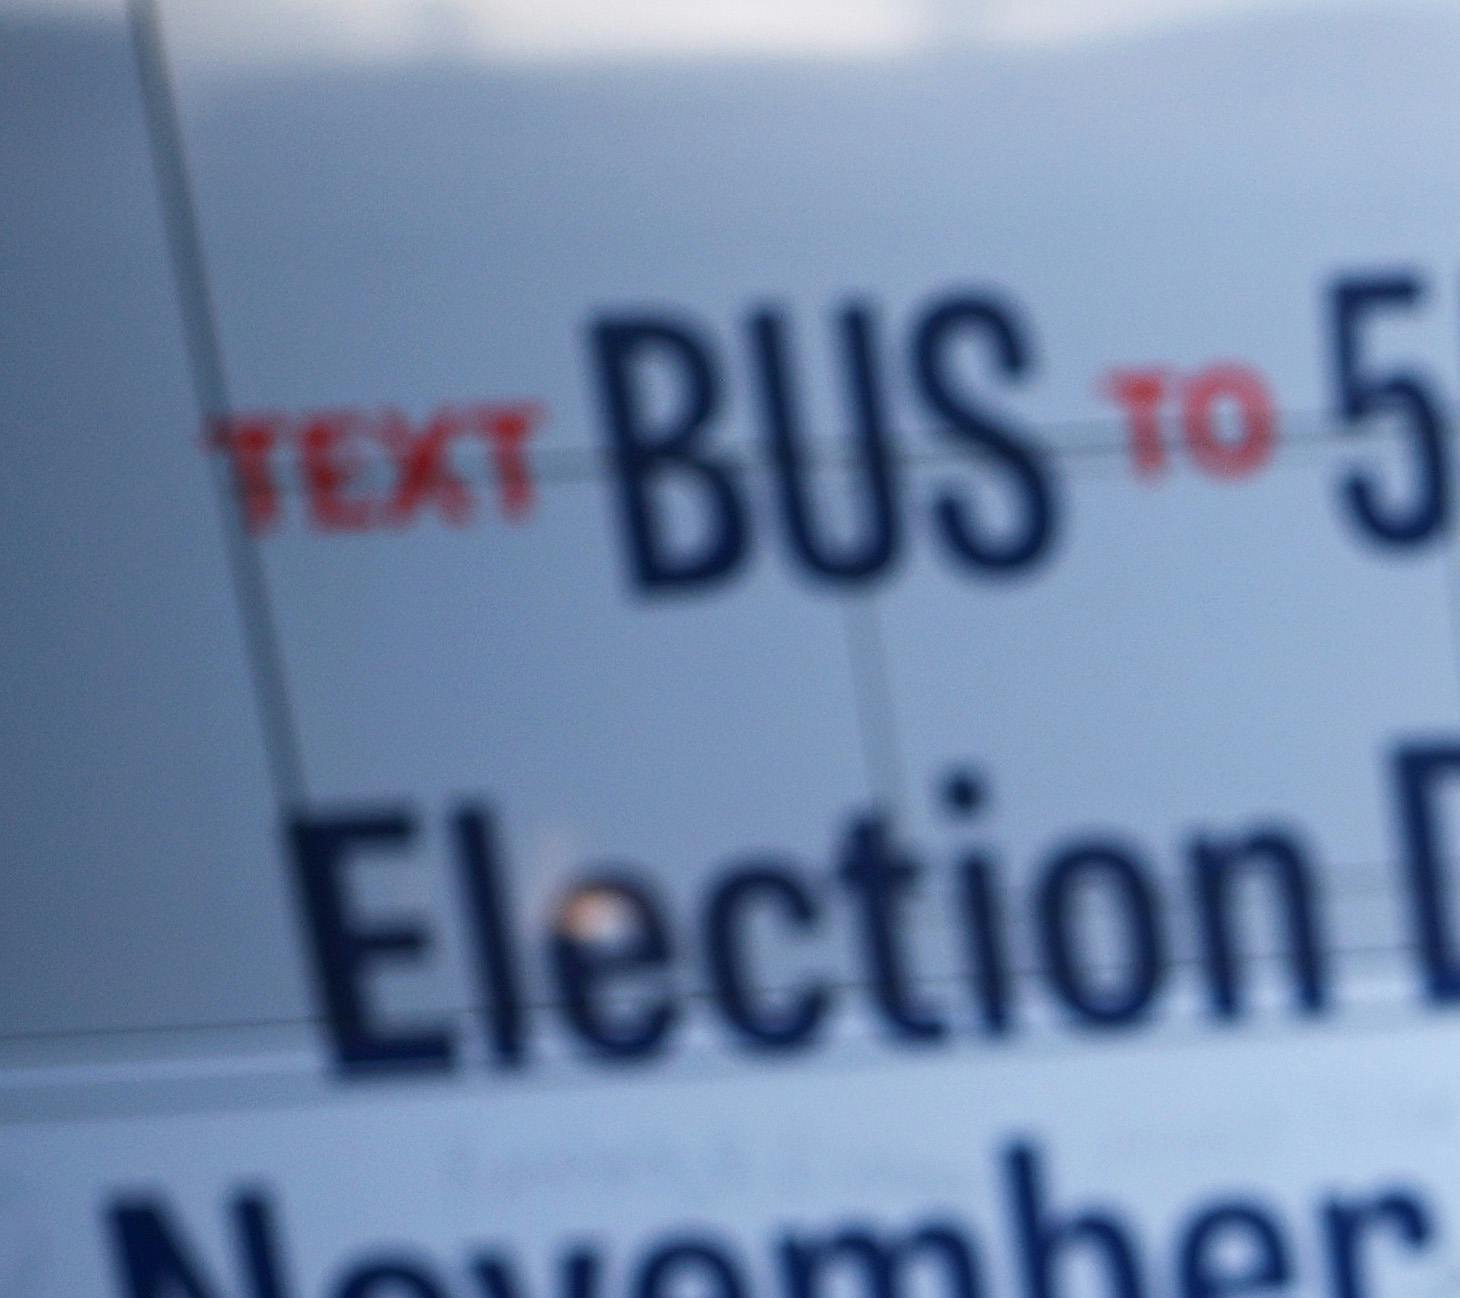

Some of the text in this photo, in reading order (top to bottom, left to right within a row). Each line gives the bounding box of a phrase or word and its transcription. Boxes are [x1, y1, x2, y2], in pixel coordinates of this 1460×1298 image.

[207, 400, 542, 538] TEXT
[586, 288, 1064, 600] BUS
[1100, 360, 1280, 482] TO
[288, 765, 1330, 1078] Election
